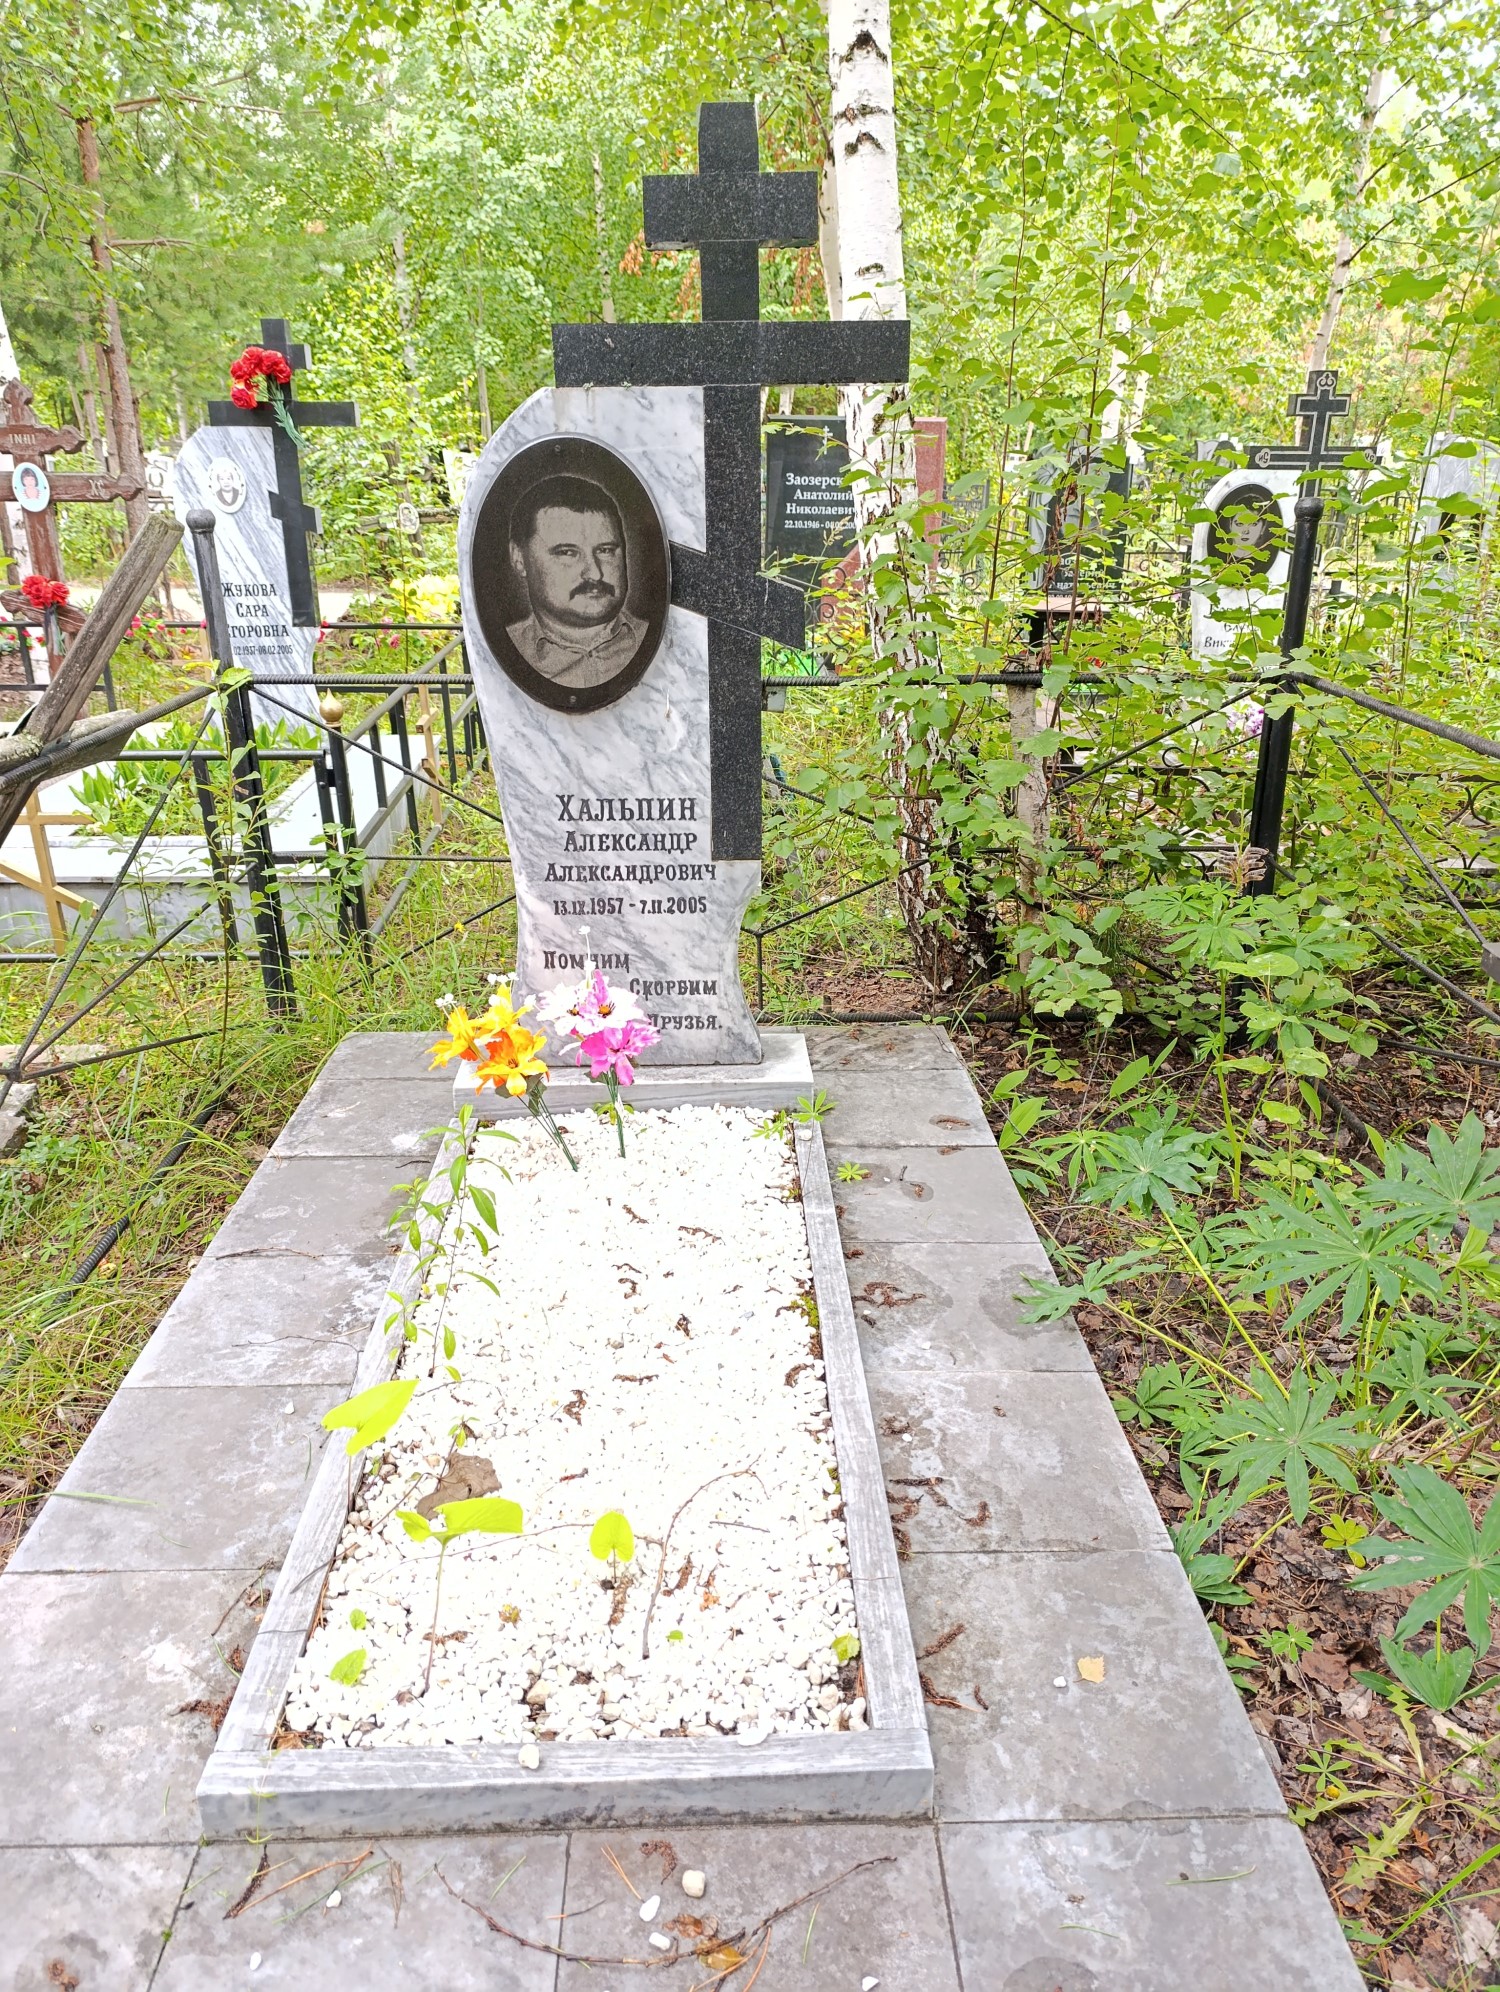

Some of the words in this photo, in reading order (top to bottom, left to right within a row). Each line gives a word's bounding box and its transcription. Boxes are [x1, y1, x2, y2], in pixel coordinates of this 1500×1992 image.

[793, 488, 854, 501] Анатолий
[784, 519, 820, 529] 22.10.1946
[222, 582, 278, 597] ЖУКОВА
[235, 602, 269, 618] САРА
[227, 624, 290, 638] ГОРОВНА
[556, 794, 697, 822] ХАЛЬПИН
[564, 830, 697, 855] АЛЕКСАНДР
[544, 862, 717, 884] АЛЕКСАНДРОВИЧ
[629, 977, 718, 1001] СКОРБИМ
